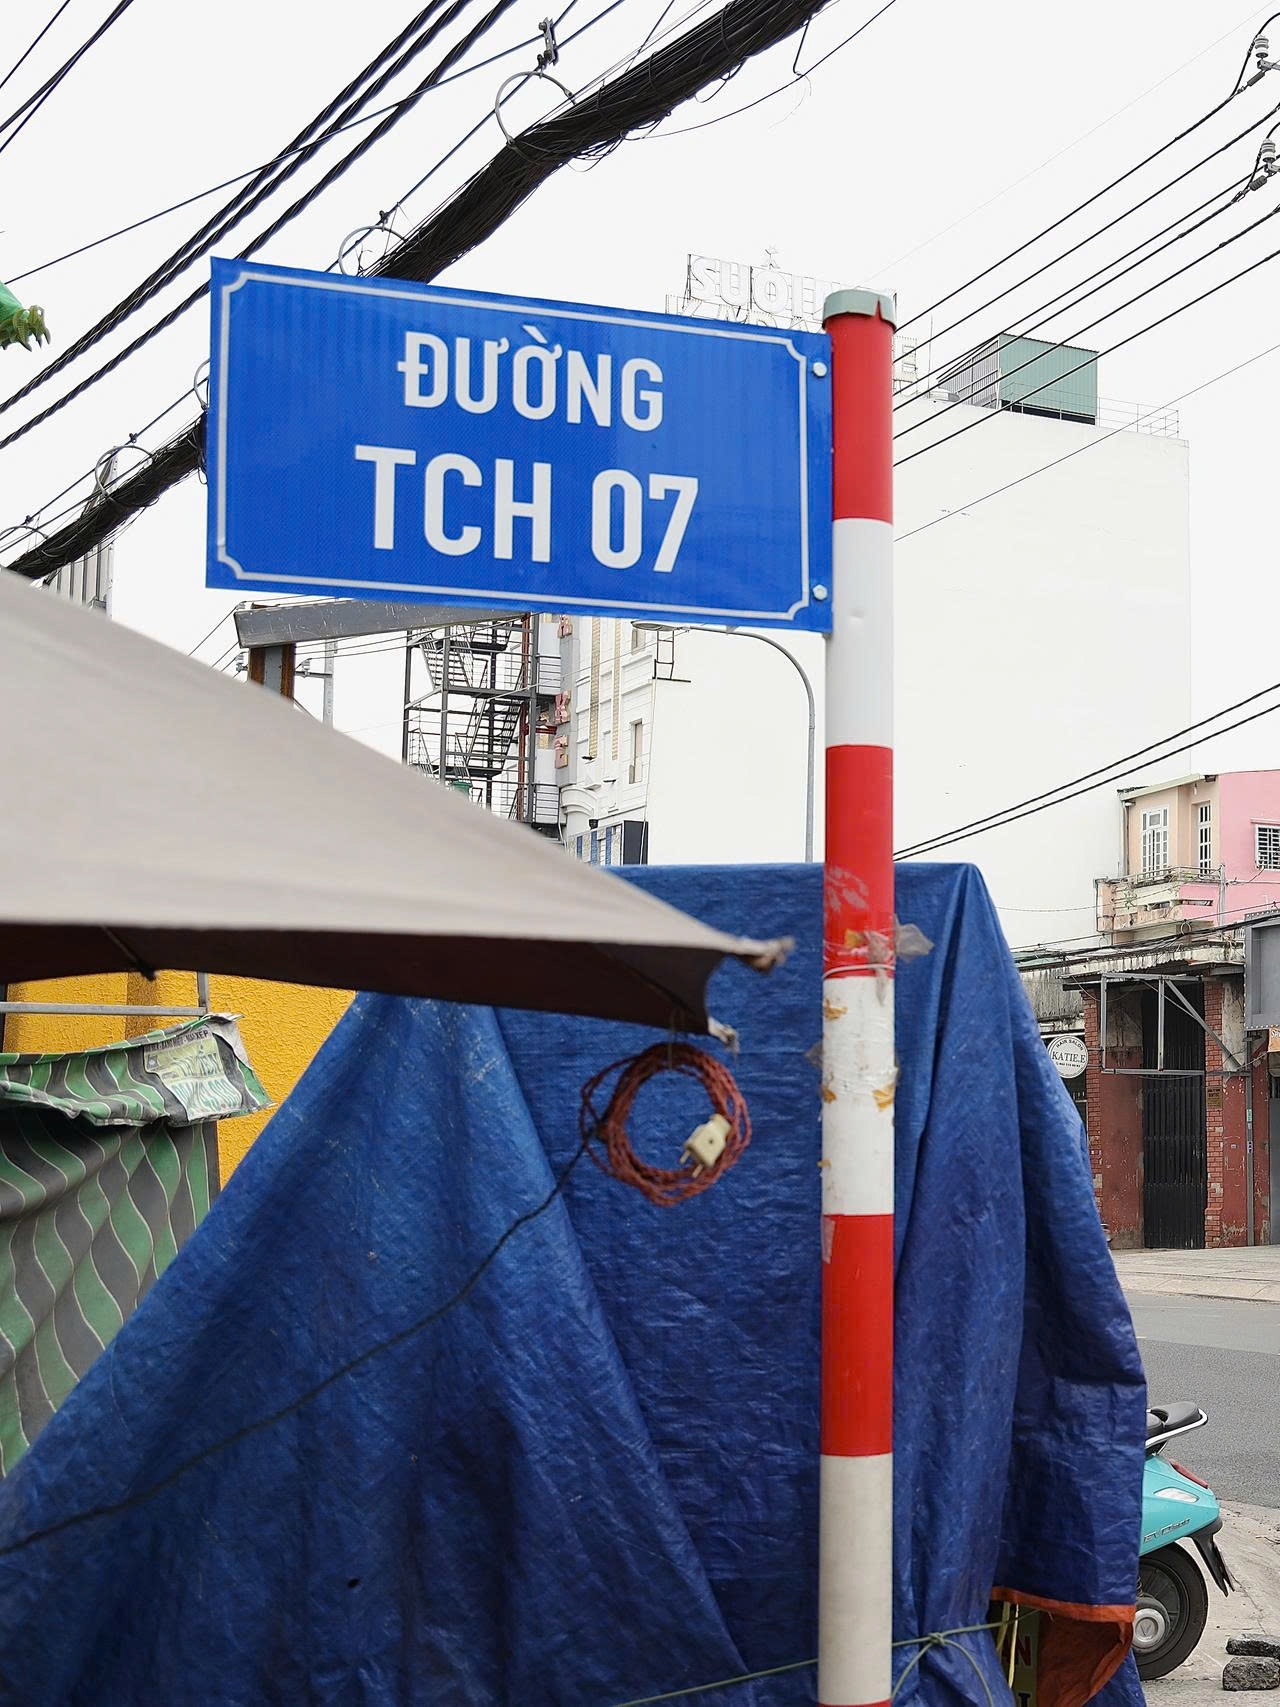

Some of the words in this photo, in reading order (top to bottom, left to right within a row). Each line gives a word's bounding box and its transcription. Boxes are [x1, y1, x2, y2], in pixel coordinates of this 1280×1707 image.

[397, 322, 665, 432] ĐƯỜNG
[355, 443, 553, 564] TCH
[590, 467, 700, 573] 07
